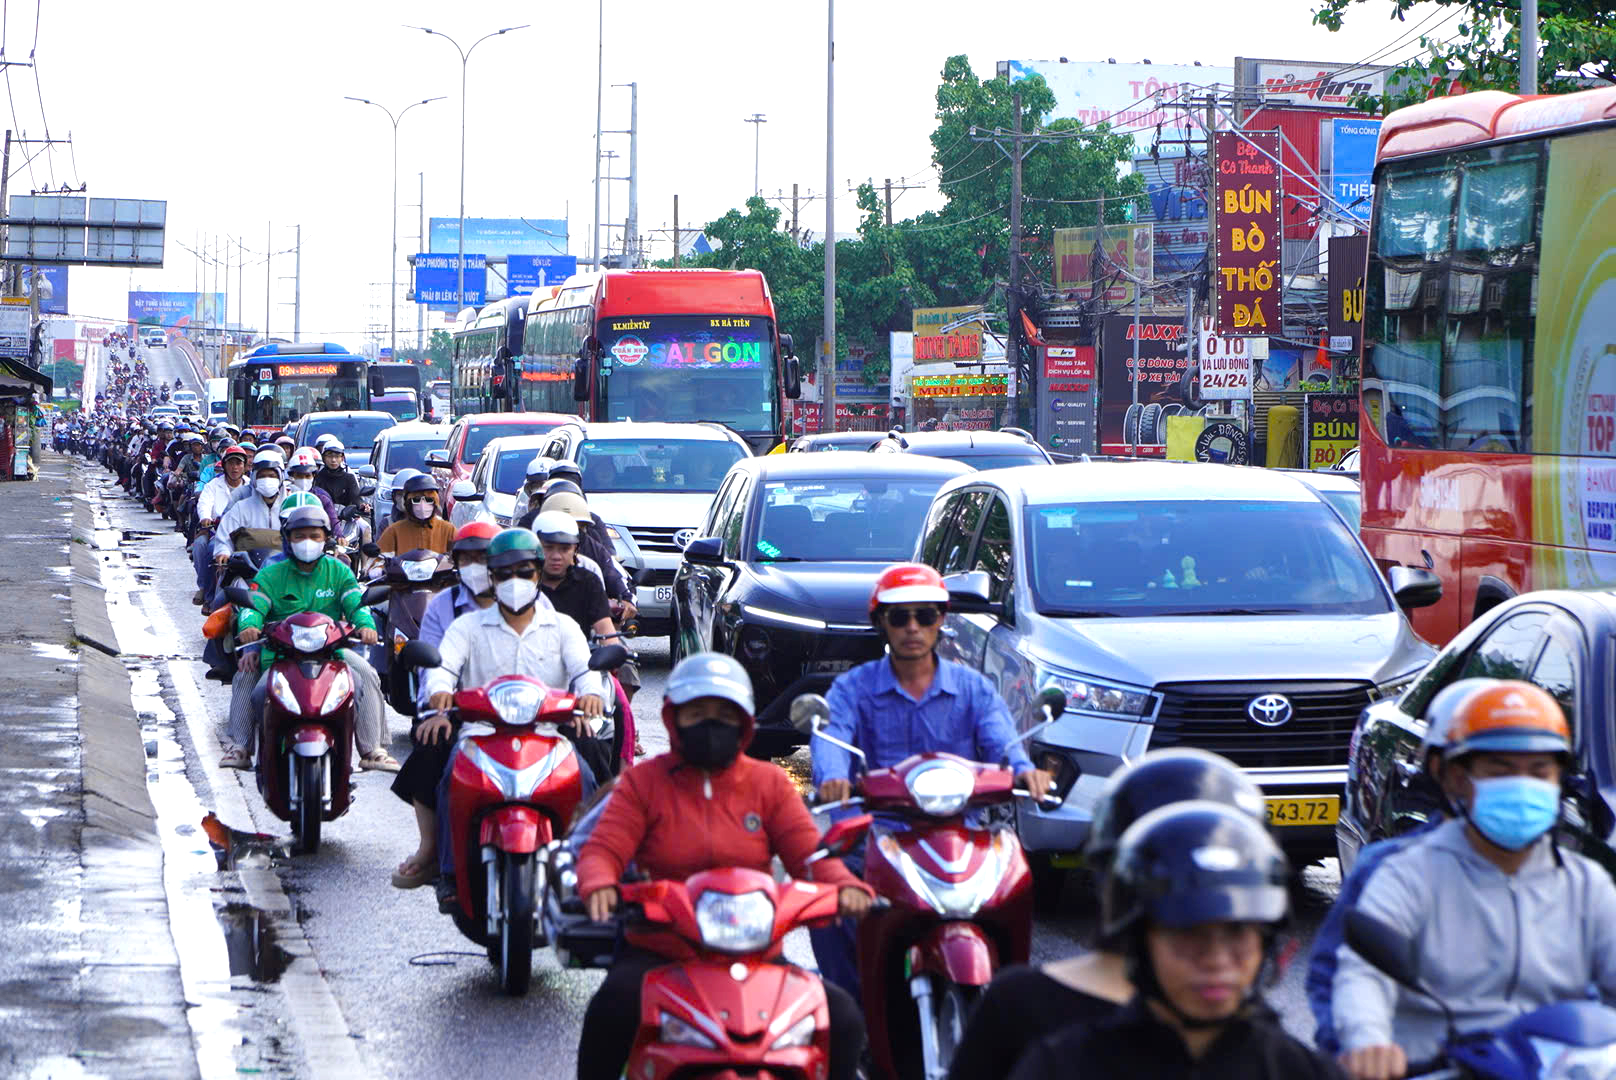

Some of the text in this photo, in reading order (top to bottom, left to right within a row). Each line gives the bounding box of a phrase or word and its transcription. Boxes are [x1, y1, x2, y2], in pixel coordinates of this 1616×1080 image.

[1358, 126, 1377, 135] CÔNG
[1221, 160, 1236, 174] Cô
[1238, 160, 1274, 174] Thanh
[1224, 183, 1272, 214] BÚN
[1231, 221, 1266, 252] BÒ
[1232, 297, 1267, 328] ĐÁ
[710, 319, 720, 327] BX
[650, 335, 761, 364] SÀI GÒN
[1206, 333, 1218, 355] Ô
[261, 370, 271, 380] 09
[1203, 373, 1248, 388] 24/24
[920, 386, 961, 395] MINH
[1313, 418, 1356, 438] BÚN
[1587, 415, 1614, 452] TOP
[1313, 443, 1336, 464] BÒ
[1587, 521, 1613, 541] AWARD
[315, 587, 336, 598] Grab
[657, 587, 672, 600] 65
